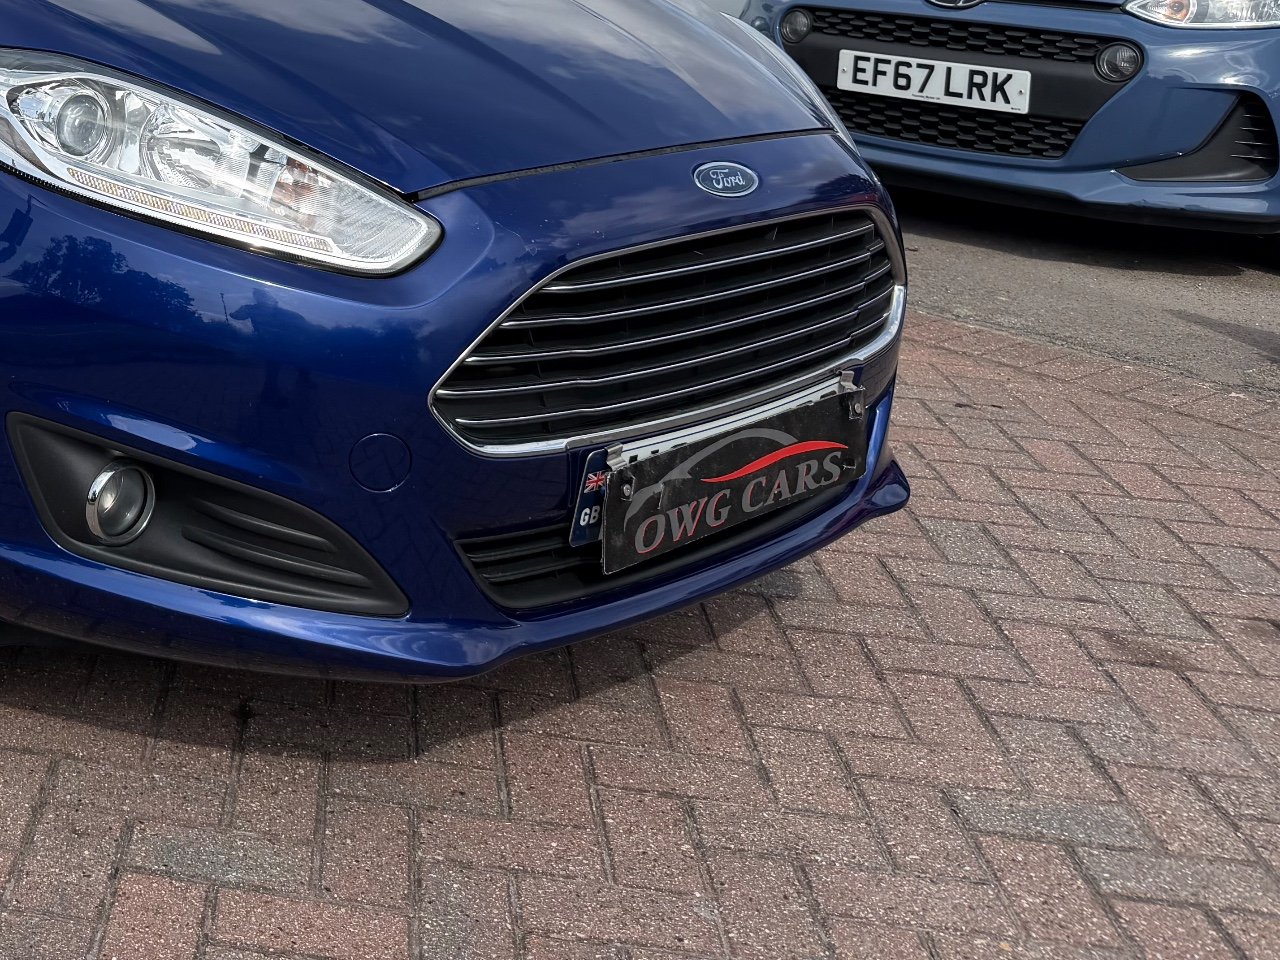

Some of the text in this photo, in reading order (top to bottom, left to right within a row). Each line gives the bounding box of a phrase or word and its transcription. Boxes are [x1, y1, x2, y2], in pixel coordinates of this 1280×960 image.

[852, 55, 1013, 105] EF67 LRK
[709, 168, 746, 189] Ford
[579, 507, 599, 527] GB
[634, 450, 842, 554] OWG CARS
